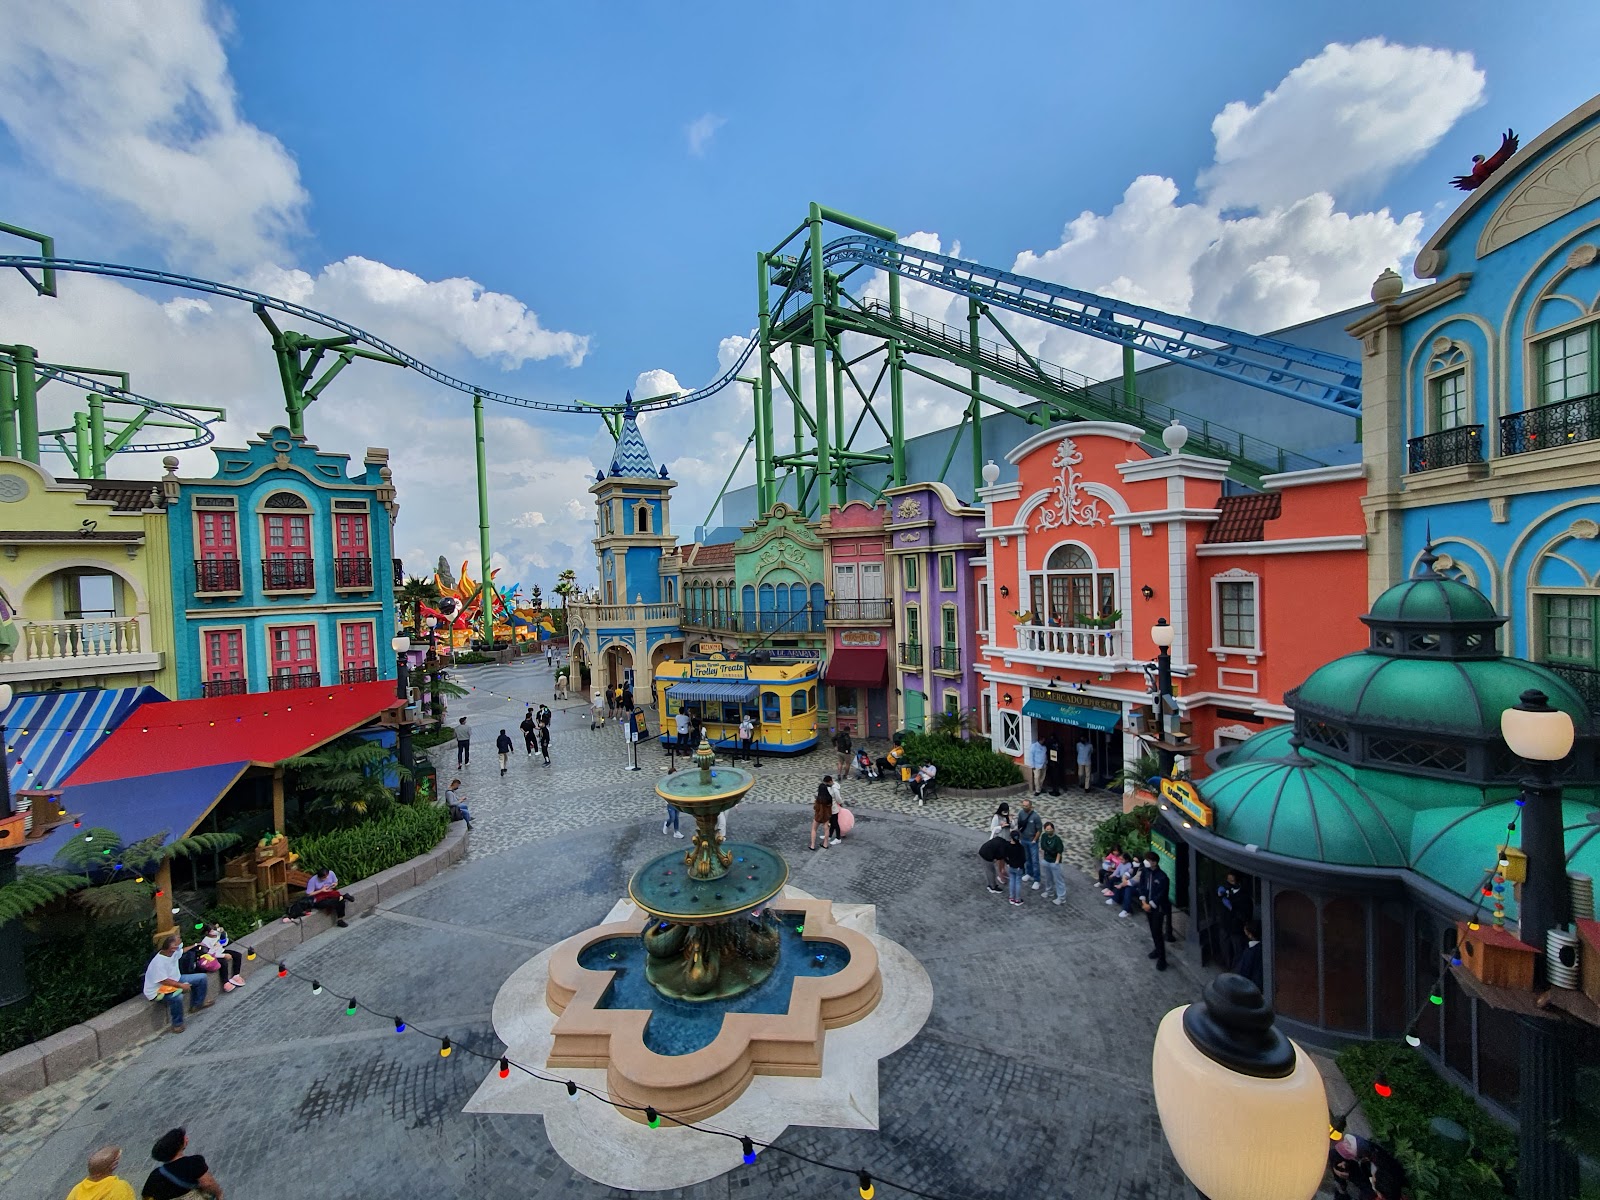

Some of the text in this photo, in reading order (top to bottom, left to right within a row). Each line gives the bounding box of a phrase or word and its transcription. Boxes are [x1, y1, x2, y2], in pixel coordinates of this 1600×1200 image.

[694, 667, 718, 677] Trolley
[719, 664, 744, 673] Treats
[1032, 689, 1046, 699] RIO
[1046, 691, 1083, 705] MERCADO
[1050, 716, 1080, 726] SOUVENIRS
